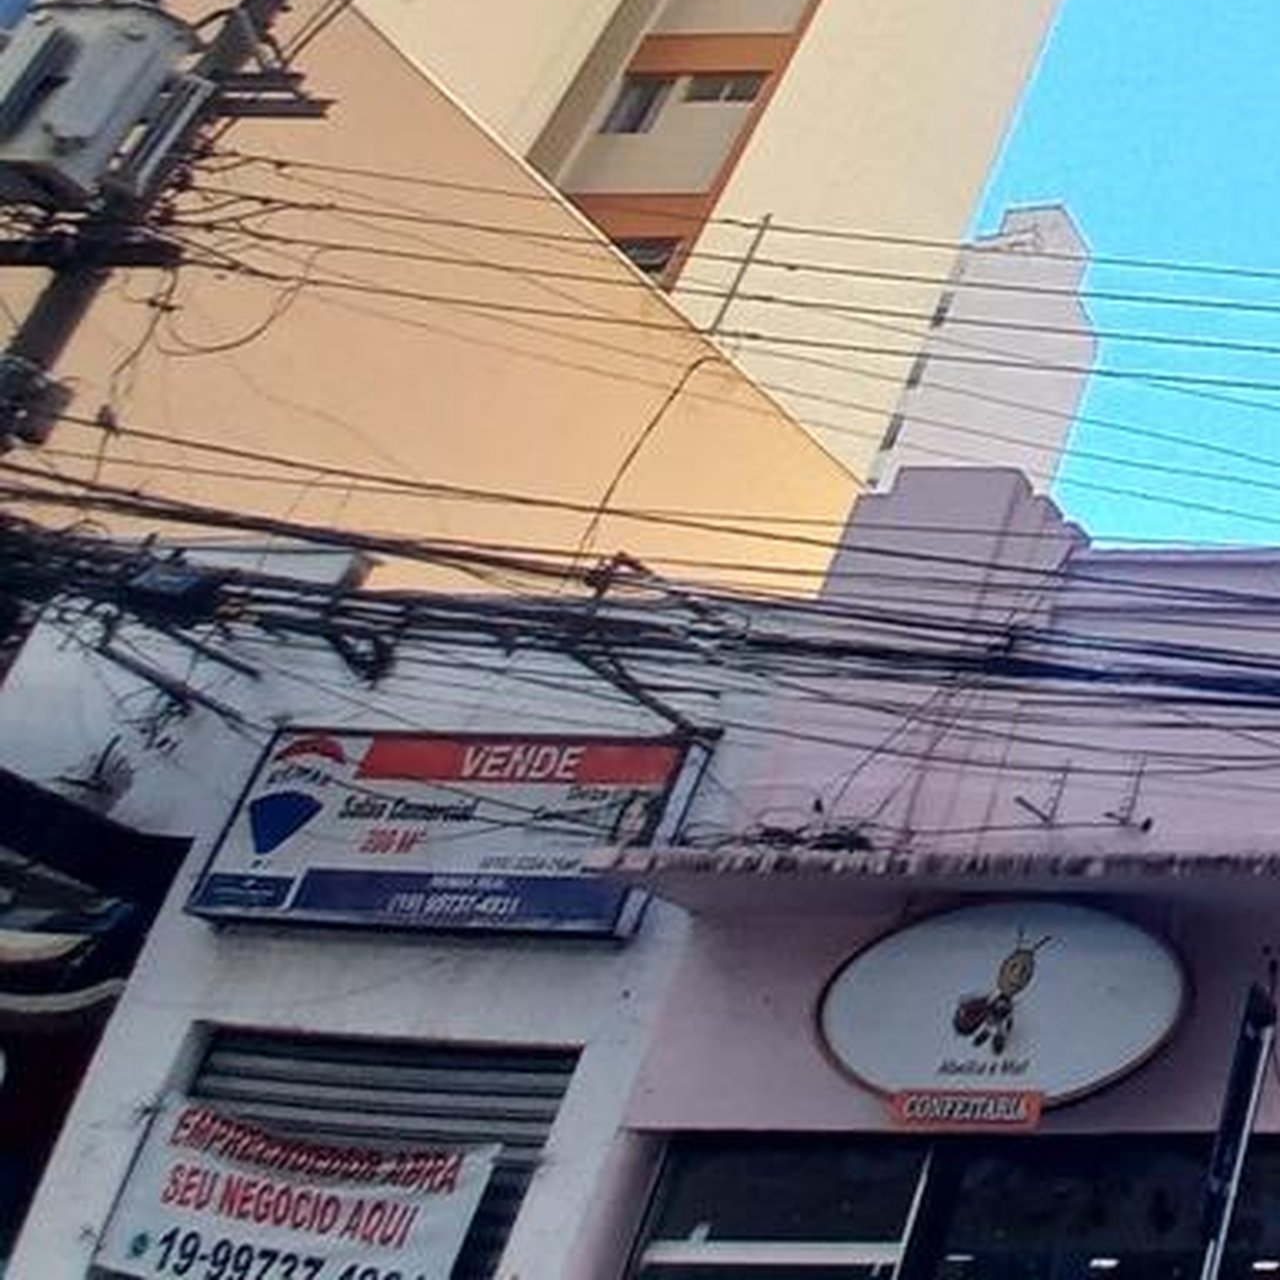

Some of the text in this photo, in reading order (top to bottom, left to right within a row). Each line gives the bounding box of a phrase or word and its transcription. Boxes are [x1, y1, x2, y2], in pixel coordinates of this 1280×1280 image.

[460, 744, 586, 779] VENDE
[160, 1163, 219, 1209] SEU
[341, 1198, 421, 1250] AQUI
